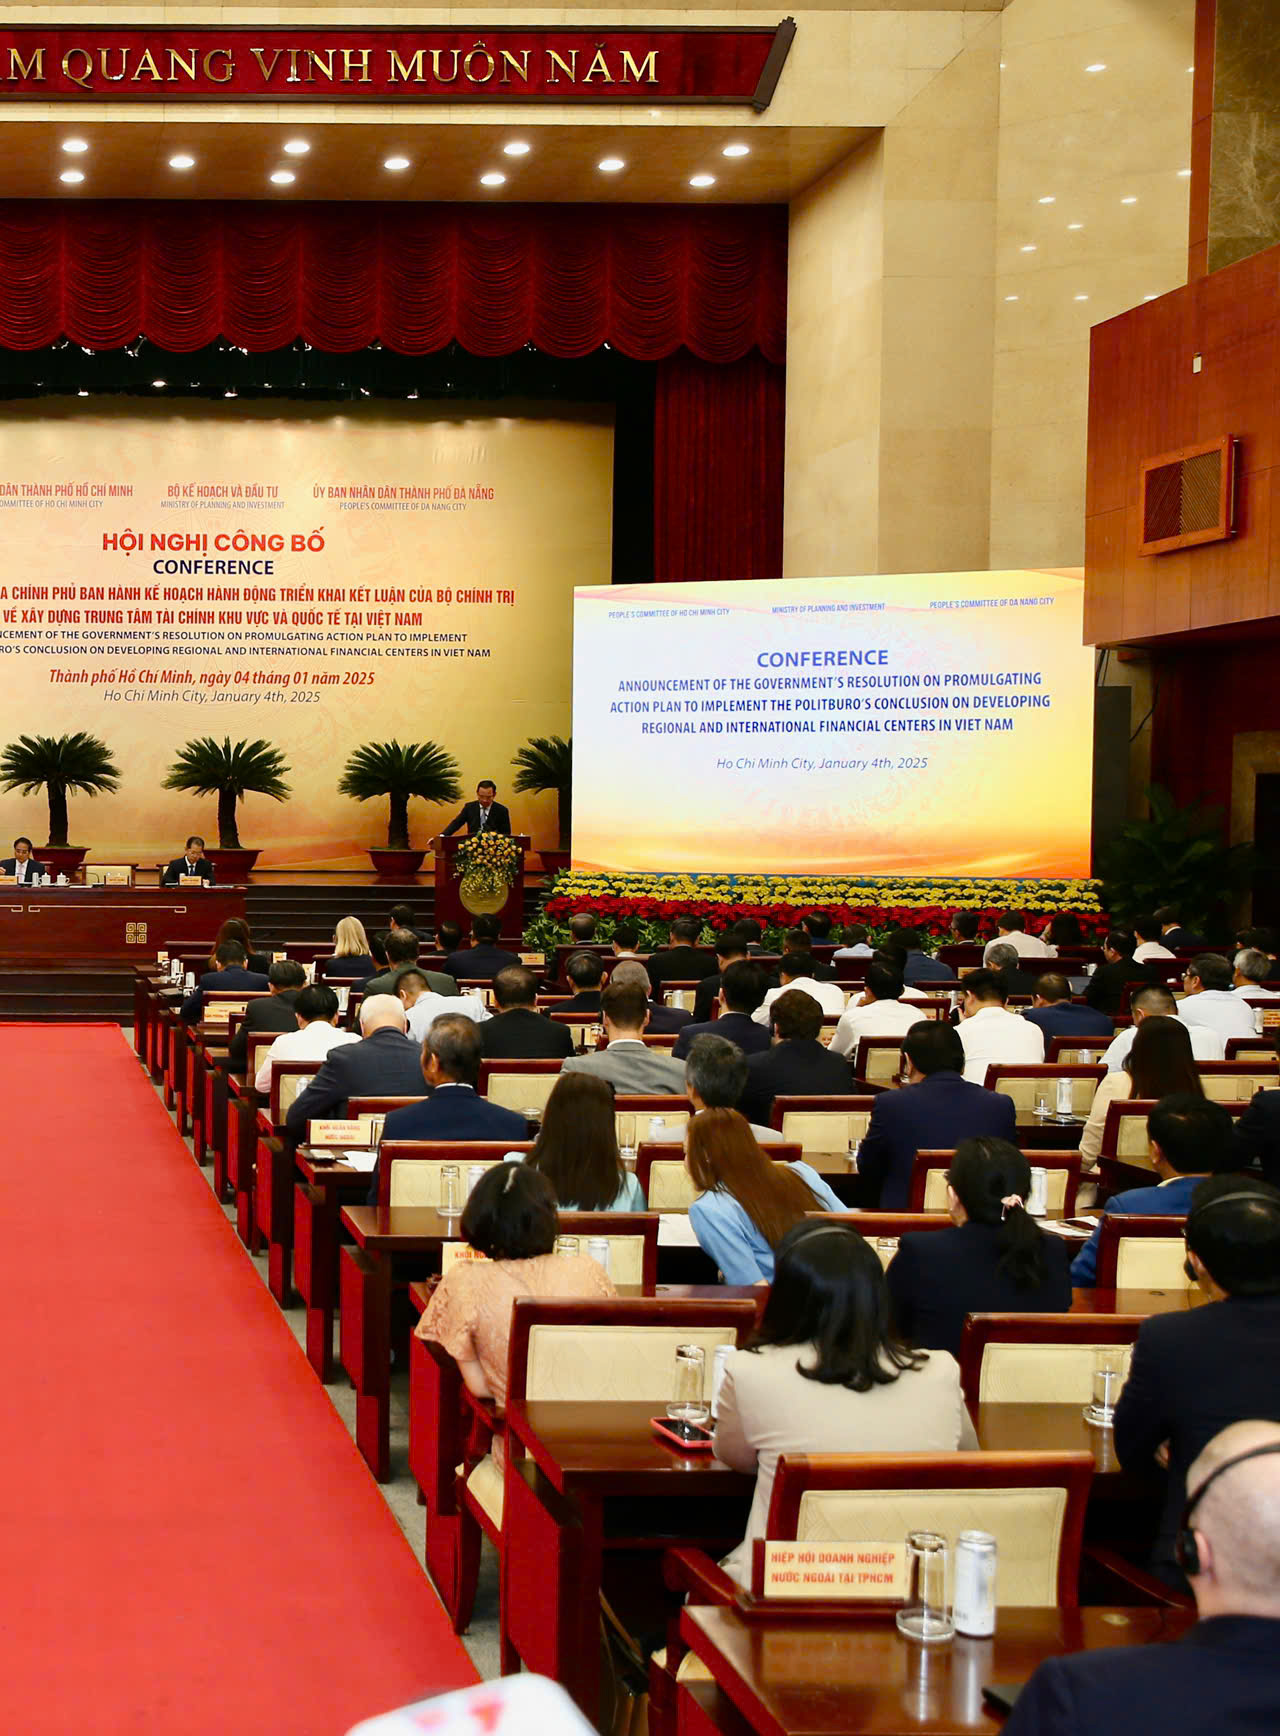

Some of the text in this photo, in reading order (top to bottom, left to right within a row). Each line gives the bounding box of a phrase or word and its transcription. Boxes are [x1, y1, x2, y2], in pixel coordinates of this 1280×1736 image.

[62, 48, 235, 89] QUANG
[250, 48, 372, 83] VINH
[387, 40, 531, 84] MUÔN
[546, 44, 659, 84] NĂM
[0, 482, 18, 497] DÂN
[21, 483, 52, 496] THÀNH
[55, 483, 73, 496] PHỐ
[76, 482, 88, 496] HỒ
[91, 485, 106, 496] CHÍ
[109, 484, 132, 496] MINH
[103, 526, 326, 557] HỘI NGHỊ CÔNG BỐ
[152, 560, 274, 575] CONFERENCE
[12, 584, 48, 600] CHÍNH
[52, 583, 76, 600] PHỦ
[80, 587, 104, 600] BAN
[108, 584, 140, 600] HÀNH
[145, 585, 159, 600] KẾ
[164, 587, 203, 603] HOẠCH
[207, 585, 239, 601] HÀNH
[243, 585, 276, 604] ĐỘNG
[280, 586, 314, 601] TRIỂN
[318, 589, 345, 601] KHAI
[350, 585, 371, 602] KẾT
[375, 586, 405, 605] LUẬN
[409, 585, 432, 602] CỦA
[437, 587, 452, 606] BỘ
[456, 587, 492, 603] CHÍNH
[496, 590, 514, 606] TRỊ
[46, 631, 57, 639] OF
[62, 631, 79, 640] THE
[82, 631, 160, 639] GOVERNMENT'S
[163, 632, 224, 640] RESOLUTION
[228, 632, 242, 640] ON
[245, 632, 323, 640] PROMULGATING
[327, 632, 363, 641] ACTION
[366, 633, 391, 641] PLAN
[394, 632, 407, 641] TO
[410, 633, 467, 642] IMPLEMENT
[757, 650, 888, 667] CONFERENCE
[51, 669, 375, 688] Thành phố Hồ Chí Minh, ngày 04 tháng 01 năm 2025
[618, 672, 1042, 691] ANNOUNCEMENT OF THE GOVERNMENT'S RESOLUTION ON PROMULGATING
[104, 689, 319, 705] Ho Chi Minh City, January 4th, 2025
[611, 695, 1051, 713] ACTION PLAN TO IMPLEMENT THE POLITBURO'S CONCLUSION ON DEVELOPING
[643, 718, 1012, 734] REGIONAL AND INTERNATIONAL FINANCIAL CENTERS IN VIET NAM
[717, 758, 928, 772] Ho Chi Minh City, January 4th, 2025
